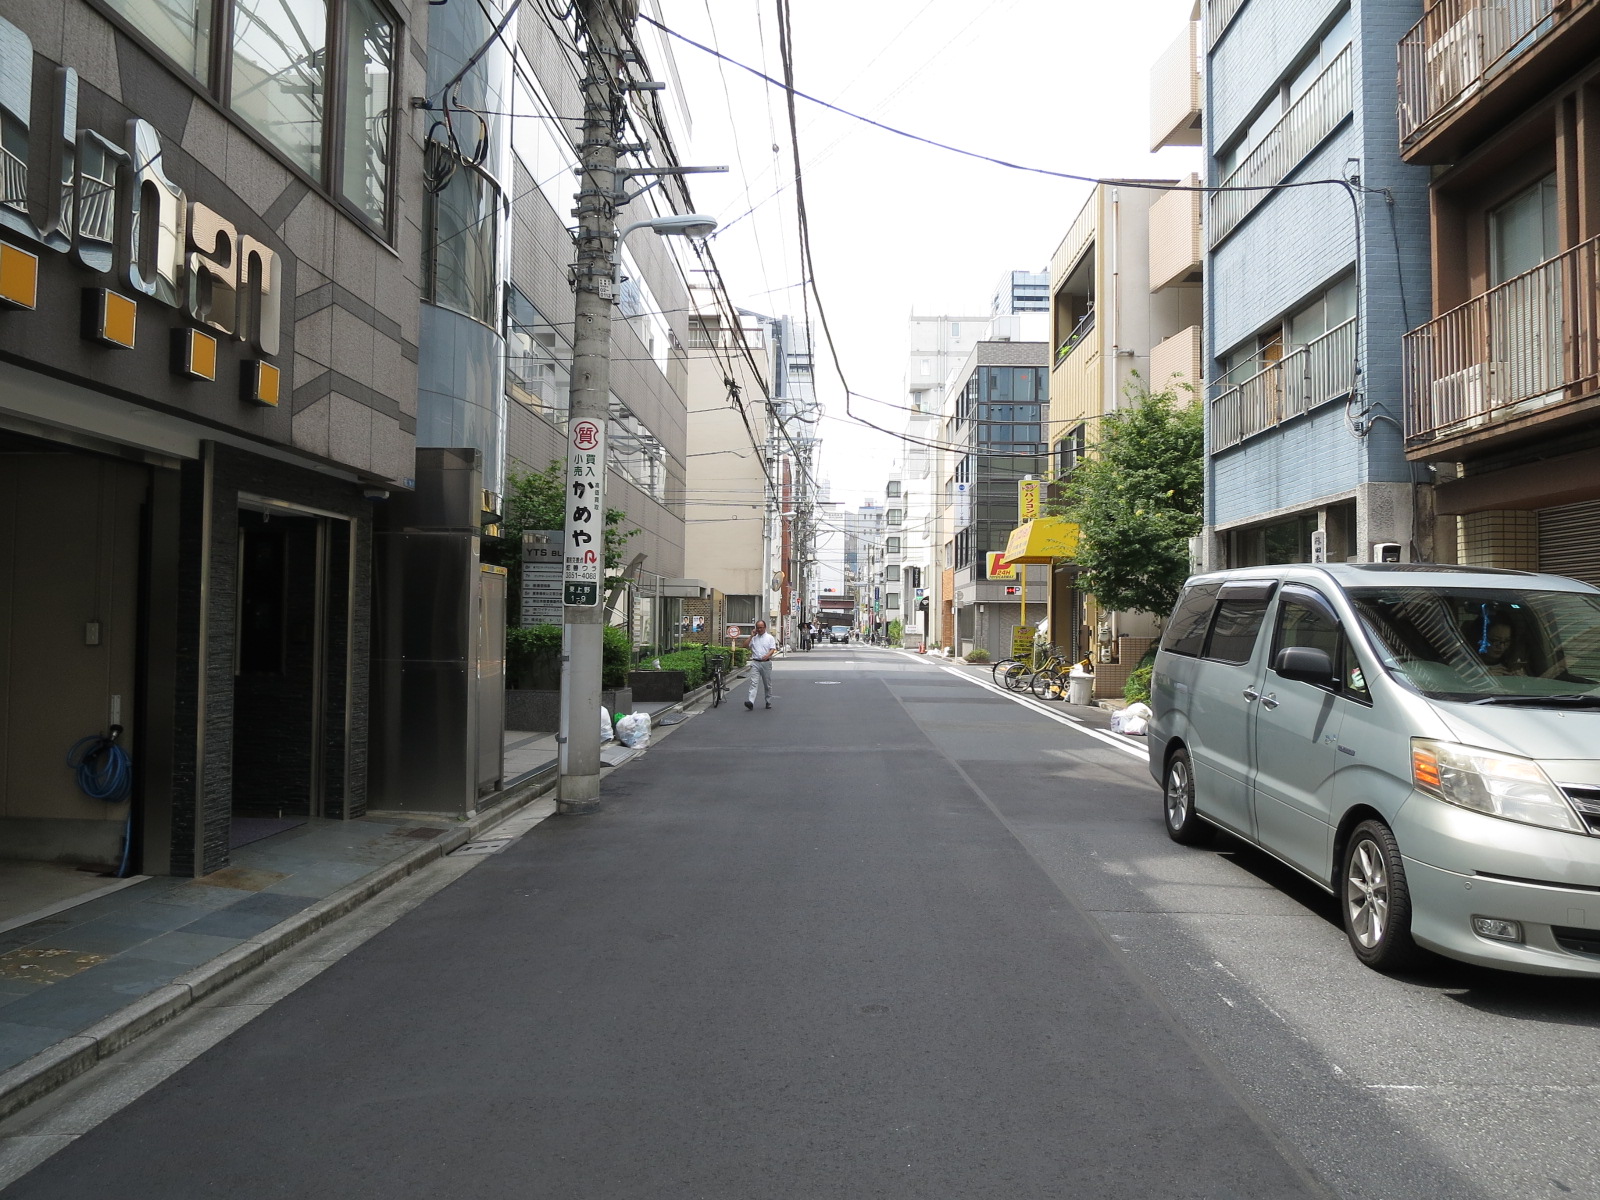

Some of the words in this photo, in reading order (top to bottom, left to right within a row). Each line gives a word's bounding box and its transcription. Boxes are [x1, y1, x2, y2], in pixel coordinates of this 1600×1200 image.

[578, 427, 593, 444] 質
[573, 454, 583, 477] 小売
[585, 454, 596, 477] 買入
[571, 480, 594, 547] かめや
[526, 548, 547, 556] YTS
